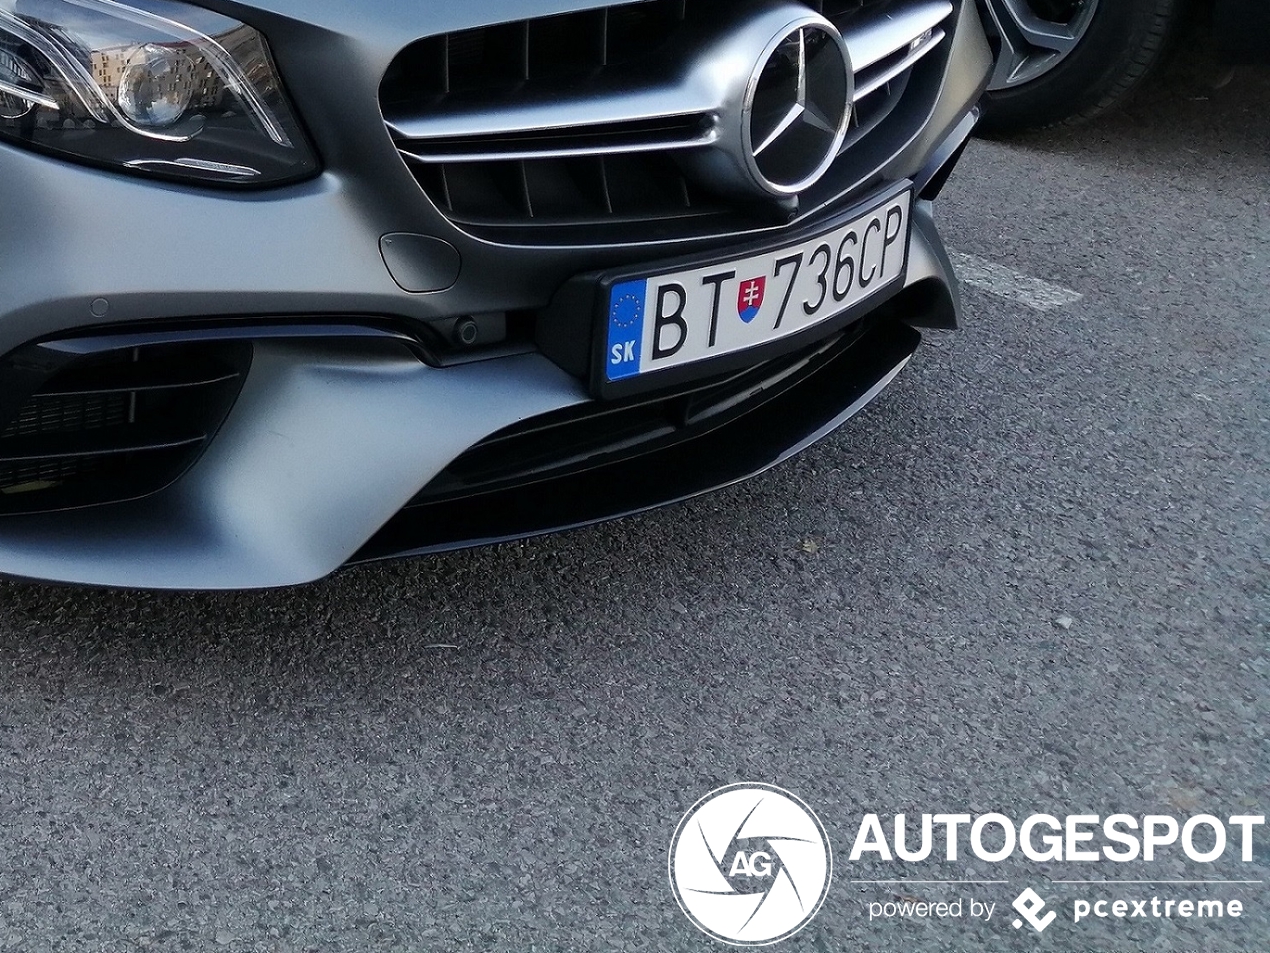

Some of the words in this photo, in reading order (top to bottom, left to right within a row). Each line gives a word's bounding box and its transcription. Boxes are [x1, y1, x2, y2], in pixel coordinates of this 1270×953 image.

[651, 268, 737, 361] BT
[772, 203, 904, 331] 736CP
[610, 339, 637, 366] SK
